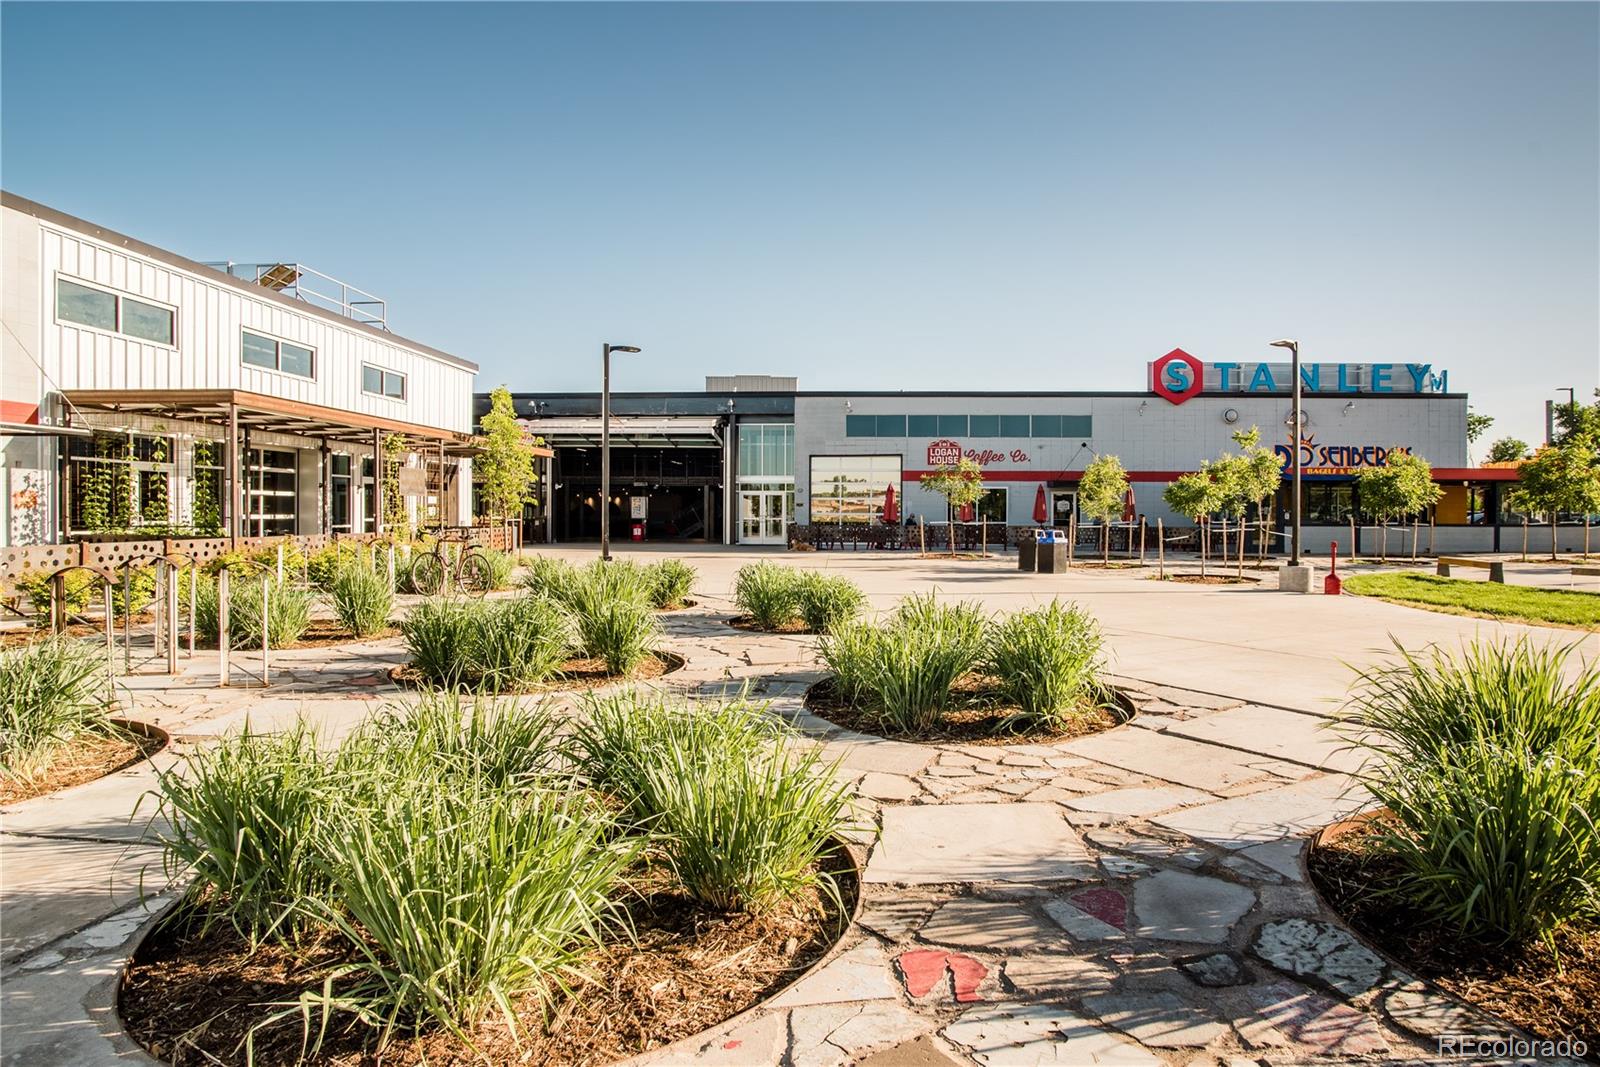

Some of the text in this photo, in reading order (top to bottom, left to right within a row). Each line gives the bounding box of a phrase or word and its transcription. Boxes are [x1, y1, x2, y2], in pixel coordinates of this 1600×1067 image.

[1166, 362, 1431, 393] STANLEY
[929, 448, 959, 456] LOGAN
[964, 449, 1031, 465] Coffee Co.
[929, 456, 959, 464] HOUSE
